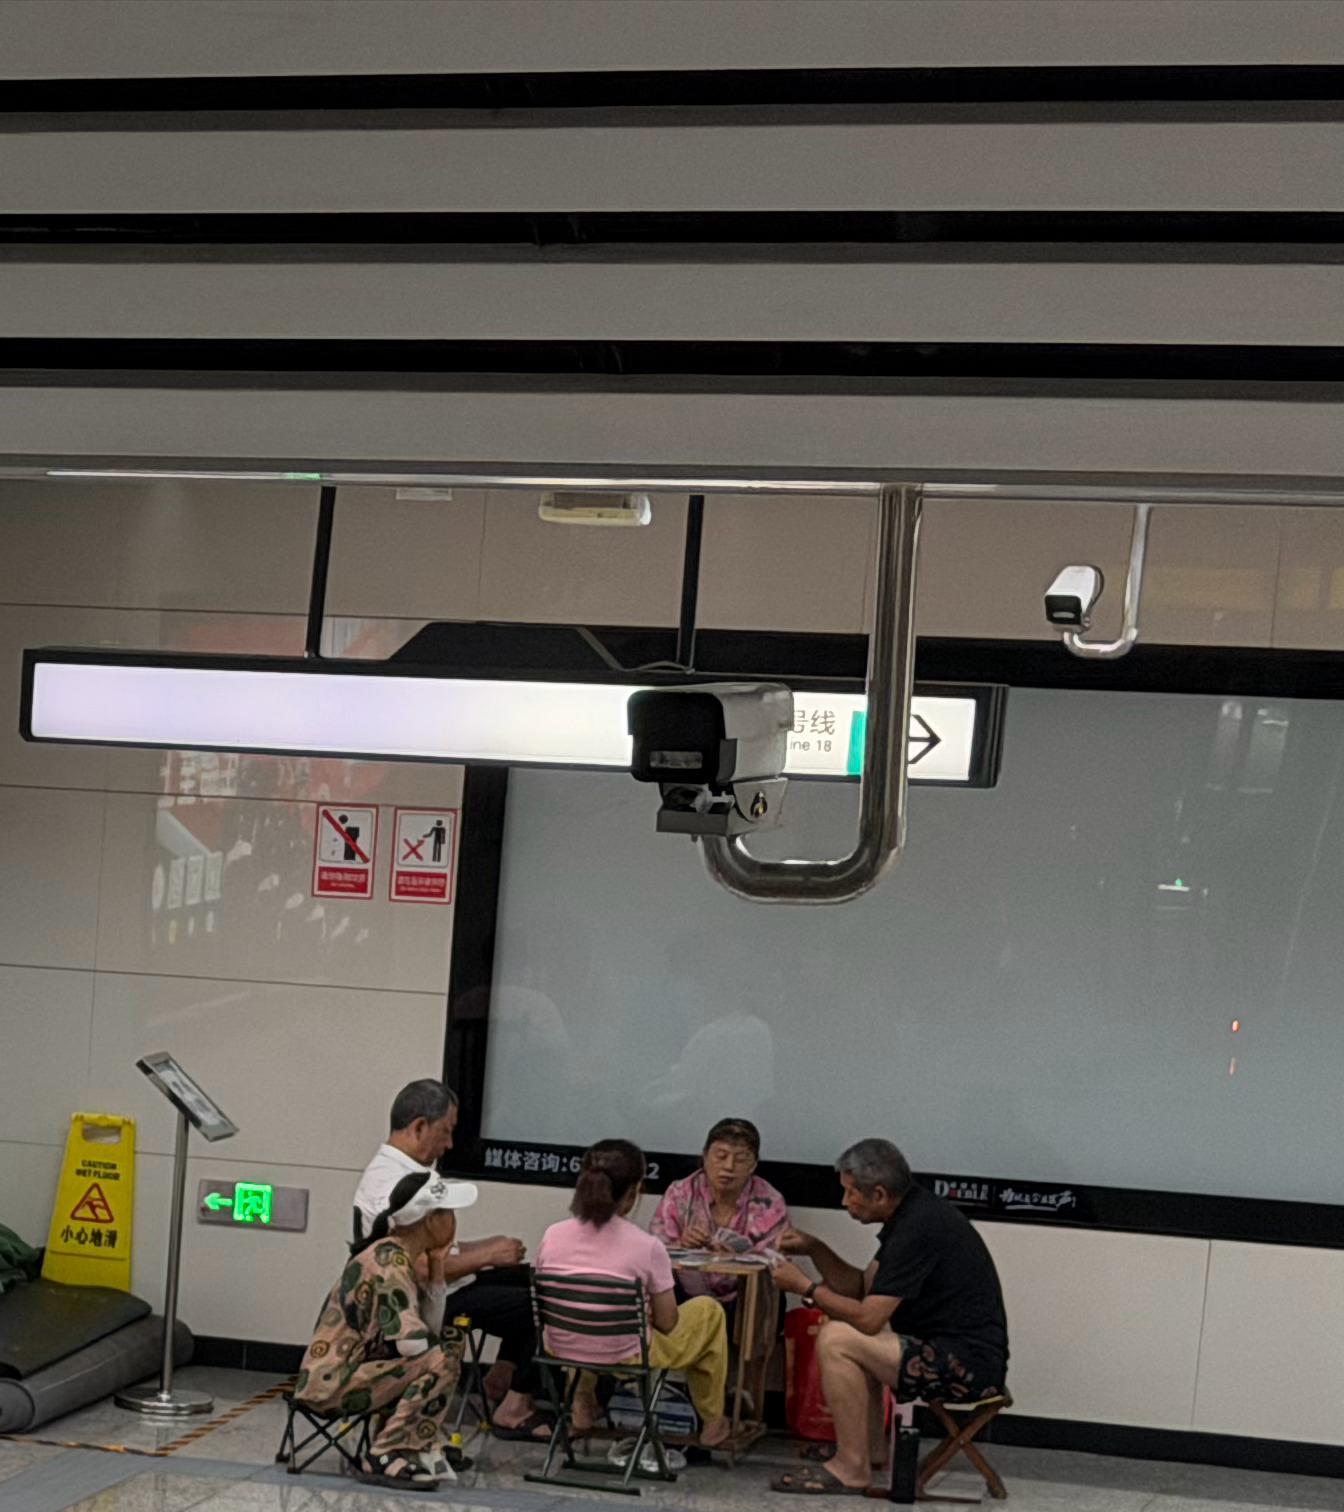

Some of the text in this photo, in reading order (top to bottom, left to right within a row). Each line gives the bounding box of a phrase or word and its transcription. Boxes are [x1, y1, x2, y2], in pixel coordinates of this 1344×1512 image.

[793, 708, 836, 735] 号线
[789, 739, 832, 752] ine 18
[81, 1159, 117, 1170] CAUTION
[60, 1225, 118, 1249] 小心地滑
